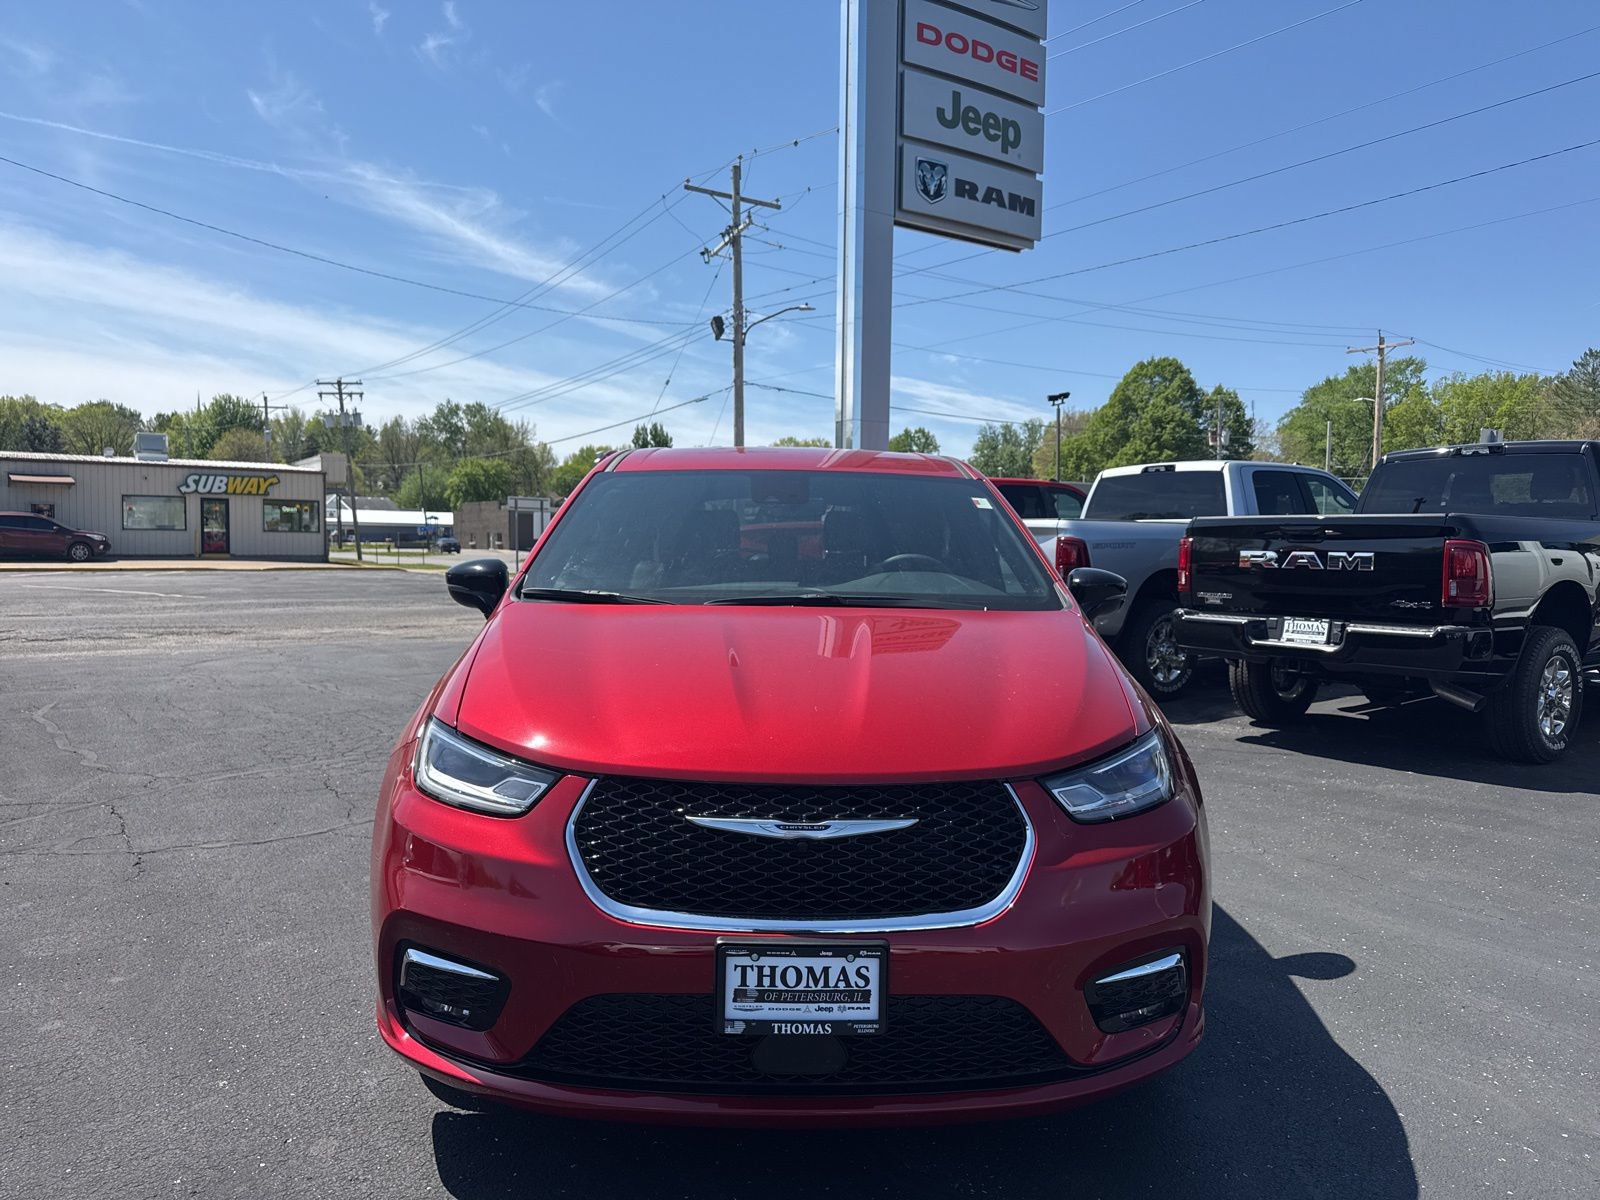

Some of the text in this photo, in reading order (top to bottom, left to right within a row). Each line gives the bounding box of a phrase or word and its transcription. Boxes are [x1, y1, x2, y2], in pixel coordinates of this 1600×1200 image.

[917, 22, 1039, 82] DODGE
[936, 90, 1021, 155] Jeep
[955, 178, 1035, 217] RAM
[179, 475, 279, 495] SUBWAY
[1239, 550, 1375, 571] RAM
[1286, 621, 1326, 631] THOMAS
[734, 964, 870, 988] THOMAS
[764, 992, 864, 1002] OF PETERSBURG, IL
[815, 1005, 834, 1013] Jeep
[772, 1023, 832, 1035] THOMAS
